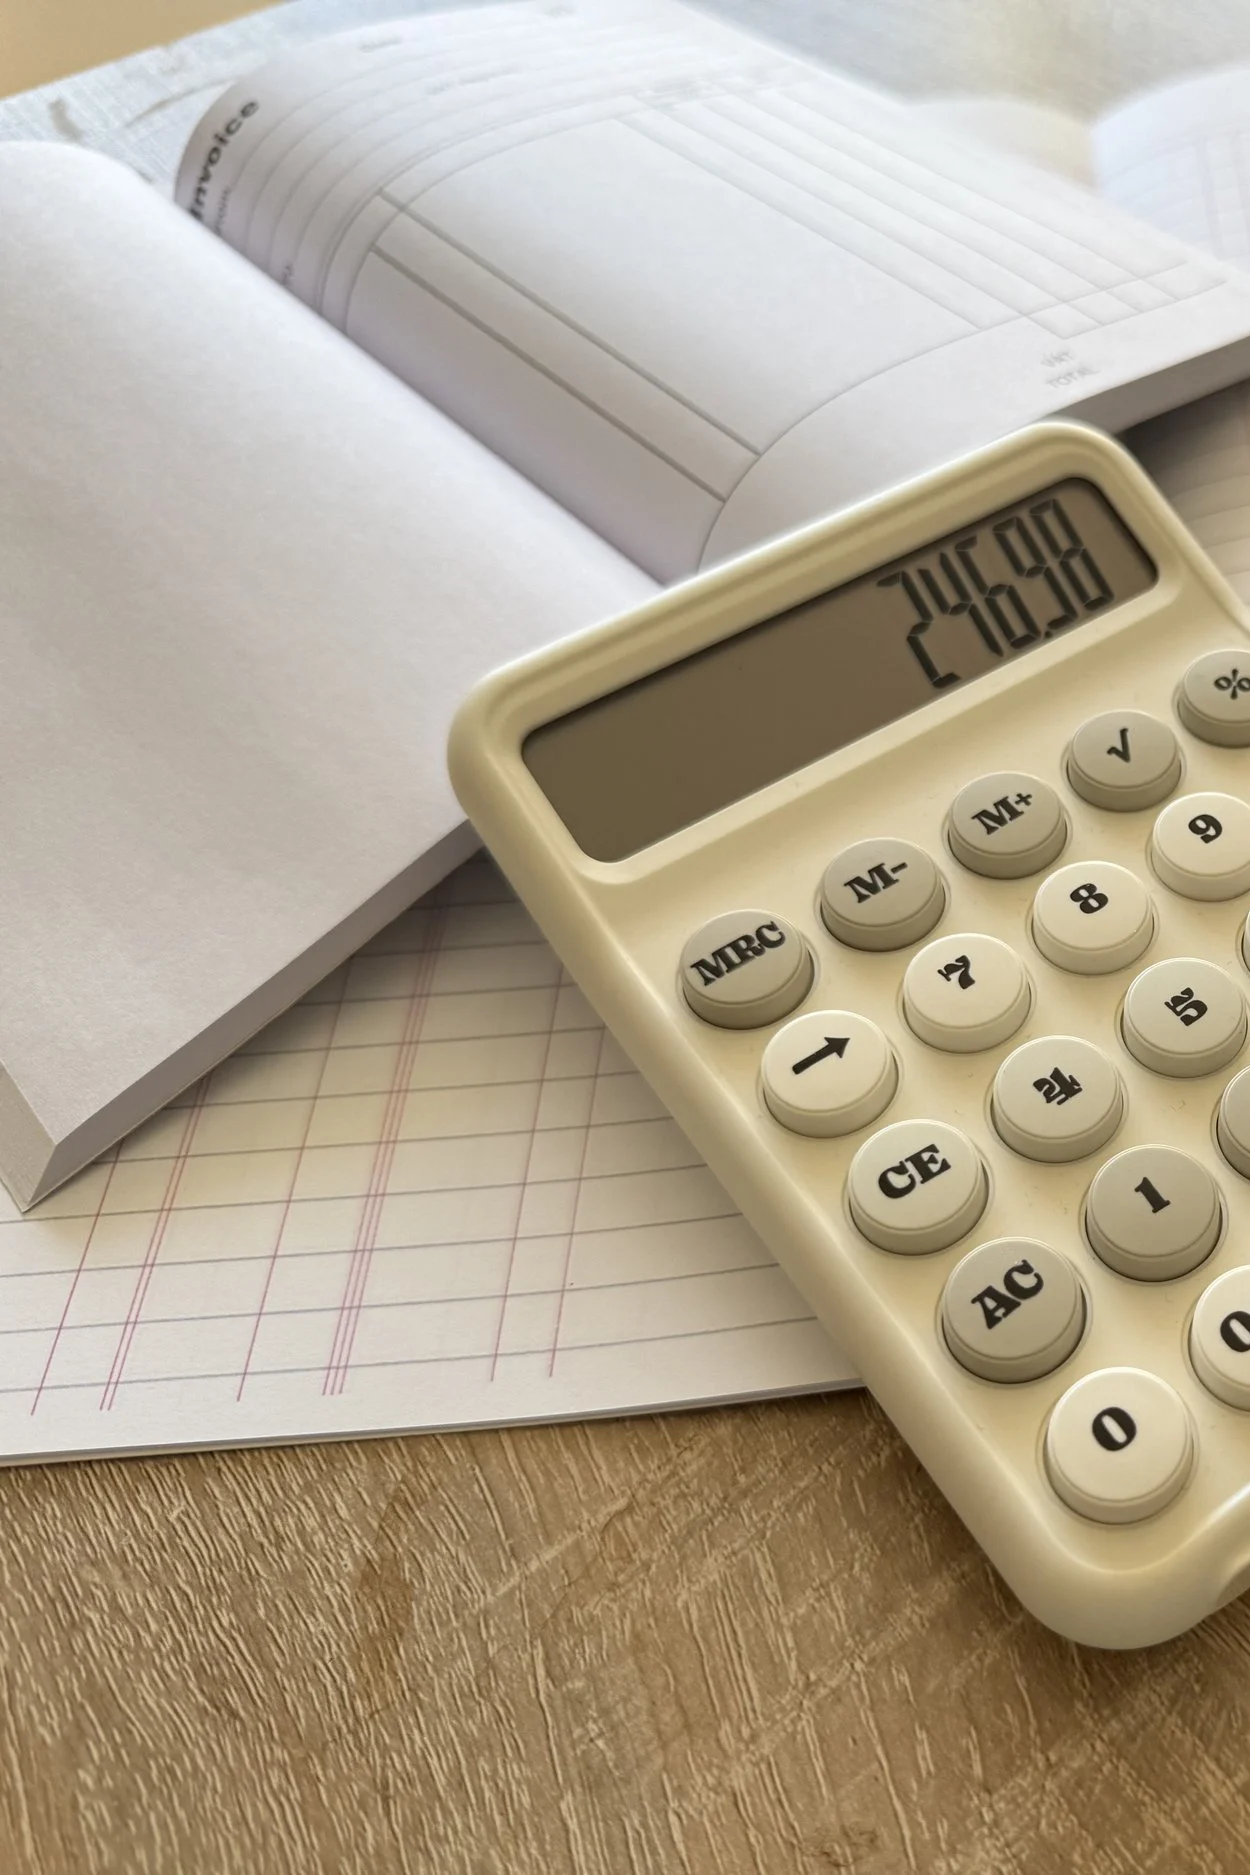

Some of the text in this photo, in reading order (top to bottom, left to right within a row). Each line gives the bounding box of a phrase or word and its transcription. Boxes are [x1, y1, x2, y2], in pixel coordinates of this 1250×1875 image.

[876, 498, 1115, 689] 246.98
[971, 792, 1033, 836] M+
[1188, 813, 1223, 844] 9
[843, 861, 908, 904] M-
[1069, 883, 1109, 915] 8
[689, 920, 786, 987] MRC
[937, 954, 976, 990] 7
[1164, 987, 1208, 1027] 5
[1033, 1066, 1083, 1106] 4
[878, 1143, 952, 1200] CE
[1134, 1176, 1171, 1214] 1
[971, 1259, 1044, 1330] AC
[1091, 1406, 1137, 1452] 0
